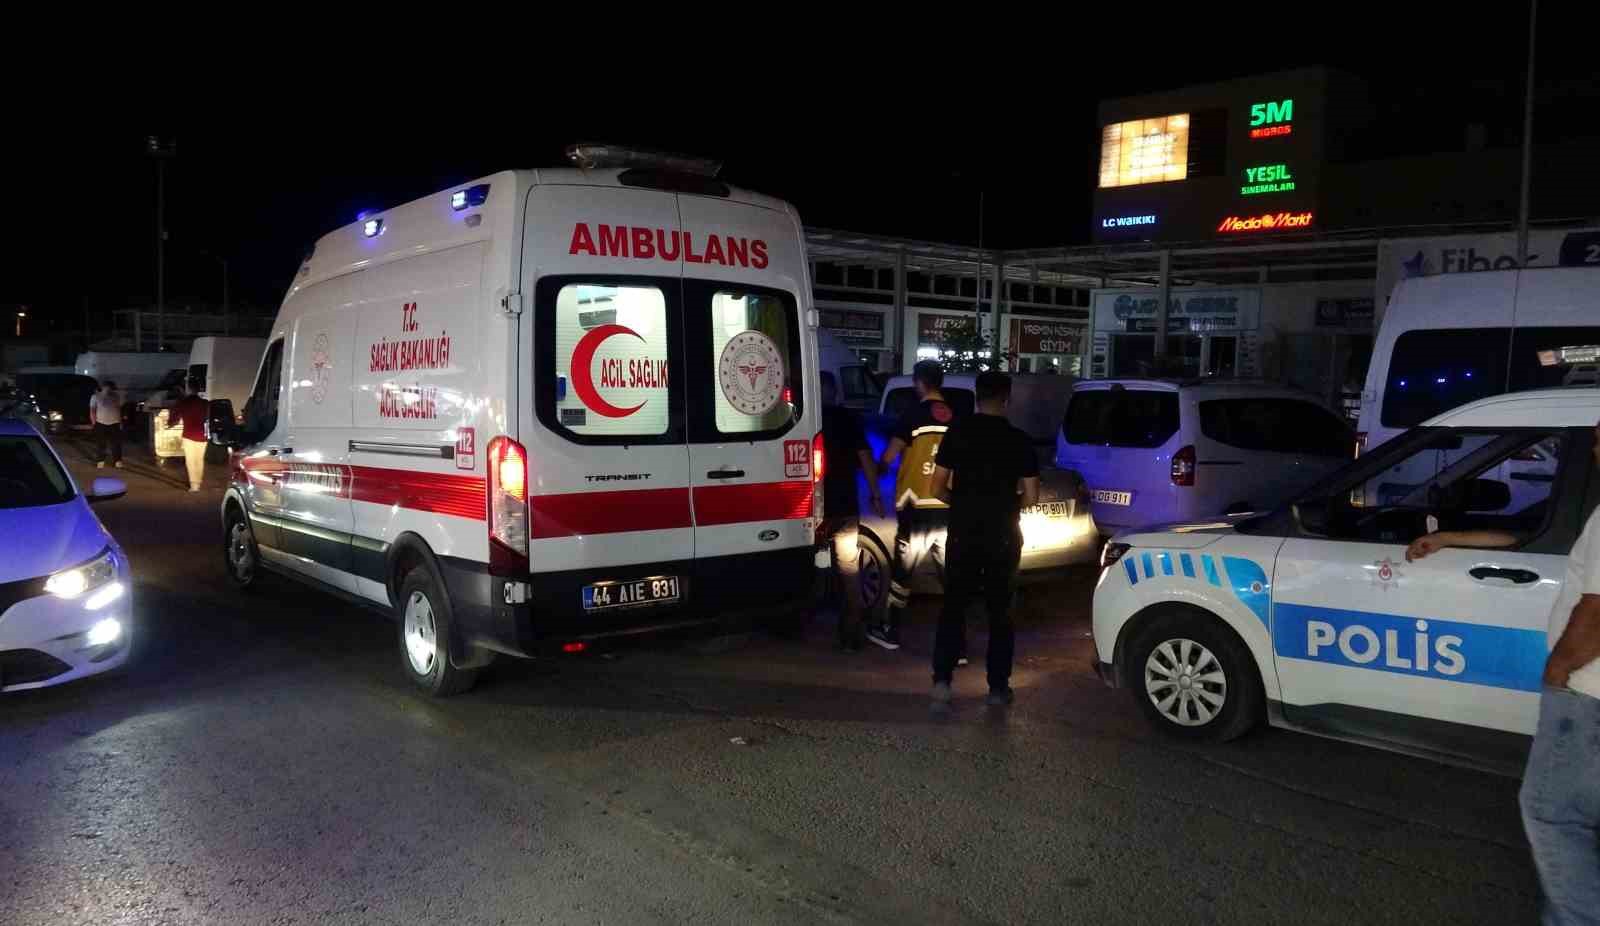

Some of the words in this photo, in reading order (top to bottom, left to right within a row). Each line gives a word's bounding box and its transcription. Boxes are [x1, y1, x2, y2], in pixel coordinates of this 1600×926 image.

[1250, 99, 1293, 126] 5M
[1103, 218, 1116, 227] LC
[568, 222, 769, 270] AMBULANS
[402, 302, 419, 332] T.C.
[370, 337, 399, 372] SAĞLIK
[399, 330, 450, 372] BAKANLIĞI
[601, 358, 626, 389] ACİL
[629, 354, 668, 388] SAĞLIK
[458, 431, 473, 452] 112
[788, 444, 807, 463] 112
[584, 473, 652, 483] TRANSIT
[592, 587, 611, 606] 44
[619, 582, 645, 603] AIE
[651, 579, 676, 598] 831
[1307, 619, 1467, 676] POLİS
